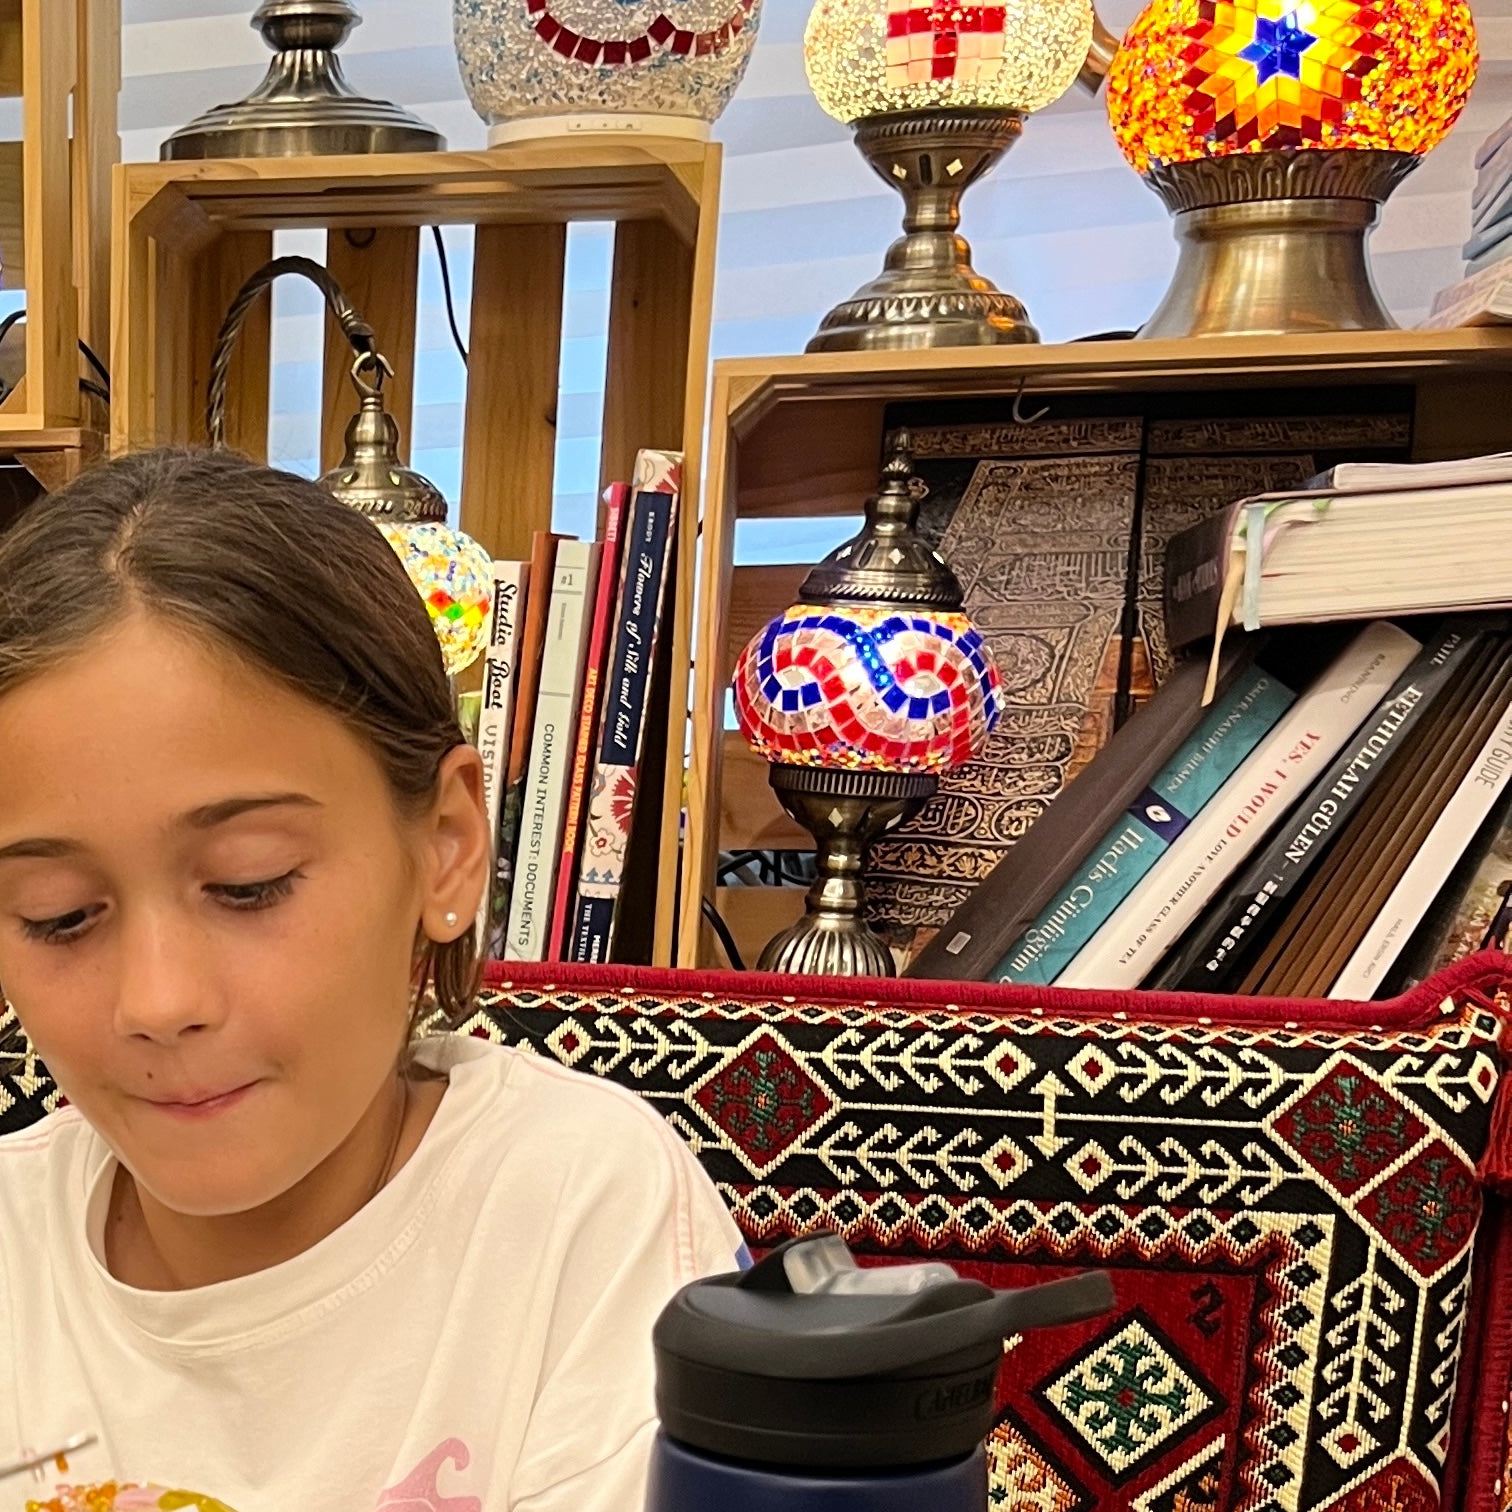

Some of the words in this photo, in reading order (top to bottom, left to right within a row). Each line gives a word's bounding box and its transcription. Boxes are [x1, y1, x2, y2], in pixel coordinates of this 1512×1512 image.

[561, 573, 574, 586] #1
[632, 551, 653, 616] Flowers
[490, 578, 517, 647] Studio
[624, 619, 643, 644] of
[623, 642, 640, 675] Silk
[1428, 631, 1462, 670] PAHL
[484, 657, 511, 710] Root
[582, 687, 595, 713] DECO
[586, 669, 598, 687] ART
[617, 676, 635, 709] and
[1338, 650, 1387, 706] BRANNING
[536, 722, 554, 784] COMMON
[1281, 726, 1322, 771] YES,
[1327, 682, 1427, 803] FETHULLAH
[572, 753, 586, 784] GLASS
[1472, 743, 1512, 791] GUIDE
[528, 788, 546, 860] INTEREST:
[1223, 777, 1279, 841] WOULD
[1281, 795, 1345, 867] GÜLEN
[562, 824, 576, 854] BOOK
[1085, 825, 1146, 889] Hadis
[1204, 837, 1228, 863] LOVE
[517, 861, 538, 946] DOCUMENTS
[1167, 862, 1208, 907] ANOTHER
[582, 902, 593, 922] THE
[1002, 875, 1100, 978] Günlüğüm
[1143, 904, 1172, 935] GLASS
[1116, 945, 1138, 967] TEA
